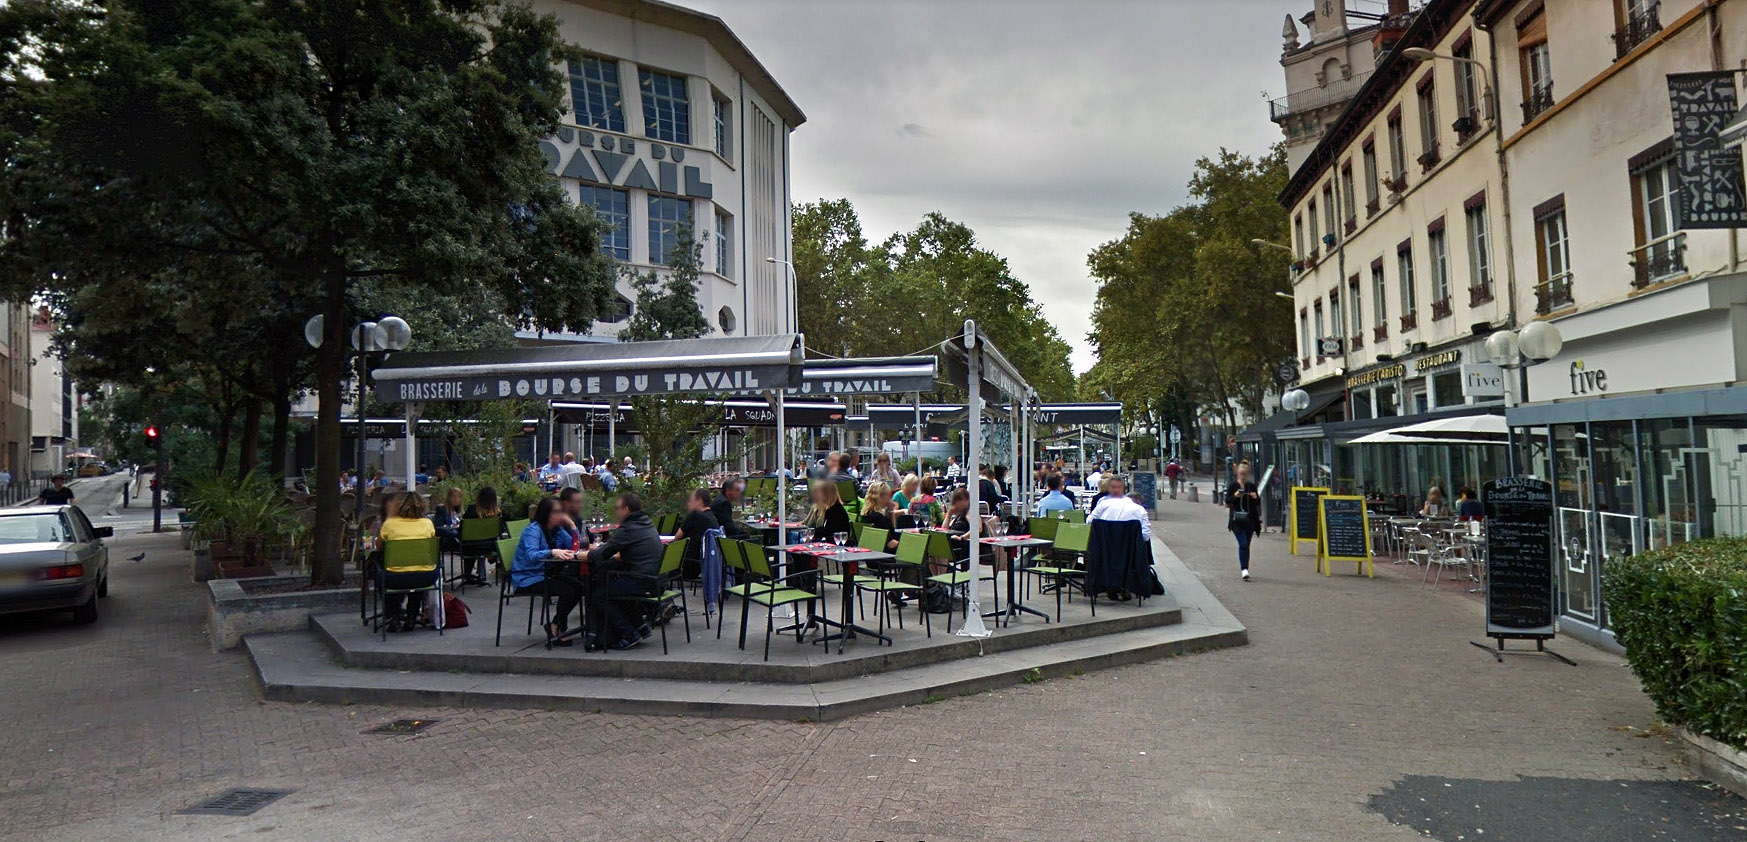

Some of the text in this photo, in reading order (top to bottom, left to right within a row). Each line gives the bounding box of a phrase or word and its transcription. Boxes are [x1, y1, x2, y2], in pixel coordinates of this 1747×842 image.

[1680, 102, 1738, 112] TRAVAIL
[558, 127, 685, 163] URSE DU
[539, 140, 713, 199] RAVAIL
[1415, 351, 1458, 370] RESTAURANT
[400, 382, 462, 399] BRASSERIE
[499, 376, 600, 396] BOURSE
[615, 375, 648, 393] DU
[664, 371, 758, 391] TRAVAIL
[1468, 371, 1500, 388] five
[1570, 360, 1607, 395] five
[823, 380, 891, 393] TRAVAIL
[725, 408, 737, 420] LA
[1495, 478, 1543, 489] BRASSERIE
[1488, 491, 1519, 500] BOURSE
